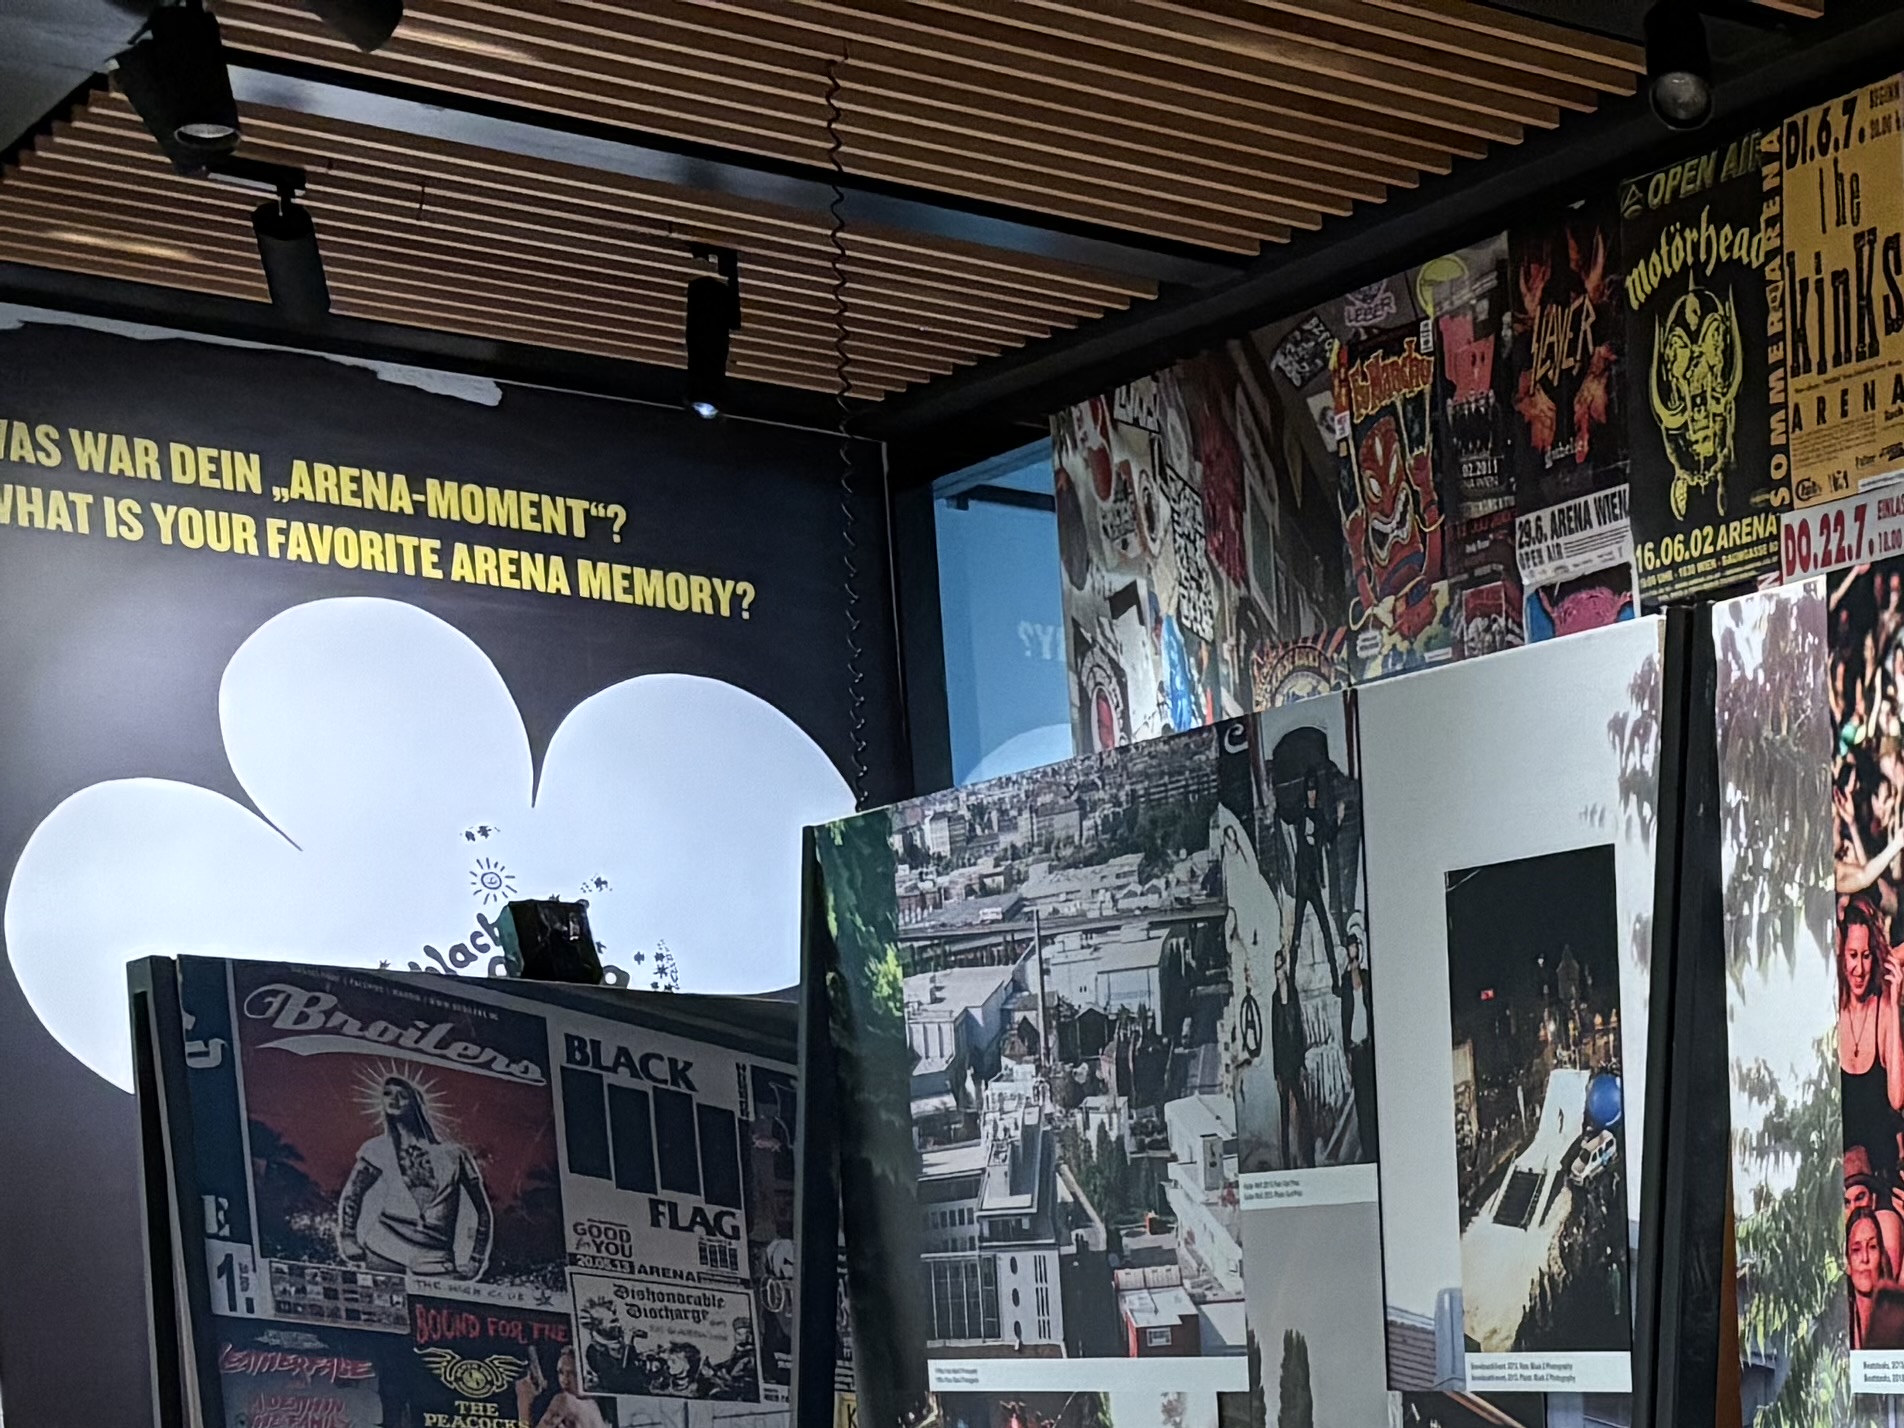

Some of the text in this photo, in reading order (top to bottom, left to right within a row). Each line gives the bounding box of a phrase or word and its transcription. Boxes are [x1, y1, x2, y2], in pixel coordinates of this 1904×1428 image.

[1782, 94, 1866, 170] DI.6.7.
[1647, 151, 1717, 210] OPEN
[1530, 294, 1594, 394] SLAYER
[0, 419, 61, 467] AS
[69, 428, 161, 480] WAR
[169, 442, 261, 494] DEIN
[1517, 493, 1629, 550] 29.6. ARENA WIEN
[1635, 512, 1778, 573] 16.06.02 ARENA
[1784, 505, 1875, 577] DO.22.7.
[104, 496, 144, 541] IS
[152, 502, 259, 556] YOUR
[266, 517, 443, 579] FAVORITE
[451, 542, 571, 596] ARENA
[577, 559, 755, 619] MEMORY?
[244, 984, 545, 1080] Broilers
[564, 1032, 699, 1092] BLACK
[573, 1222, 632, 1243] GOOD
[648, 1197, 741, 1240] FLAG
[592, 1240, 633, 1258] YOU
[638, 1263, 698, 1283] ARENA
[415, 1304, 527, 1344] BOUND FOR
[455, 1401, 499, 1417] THE
